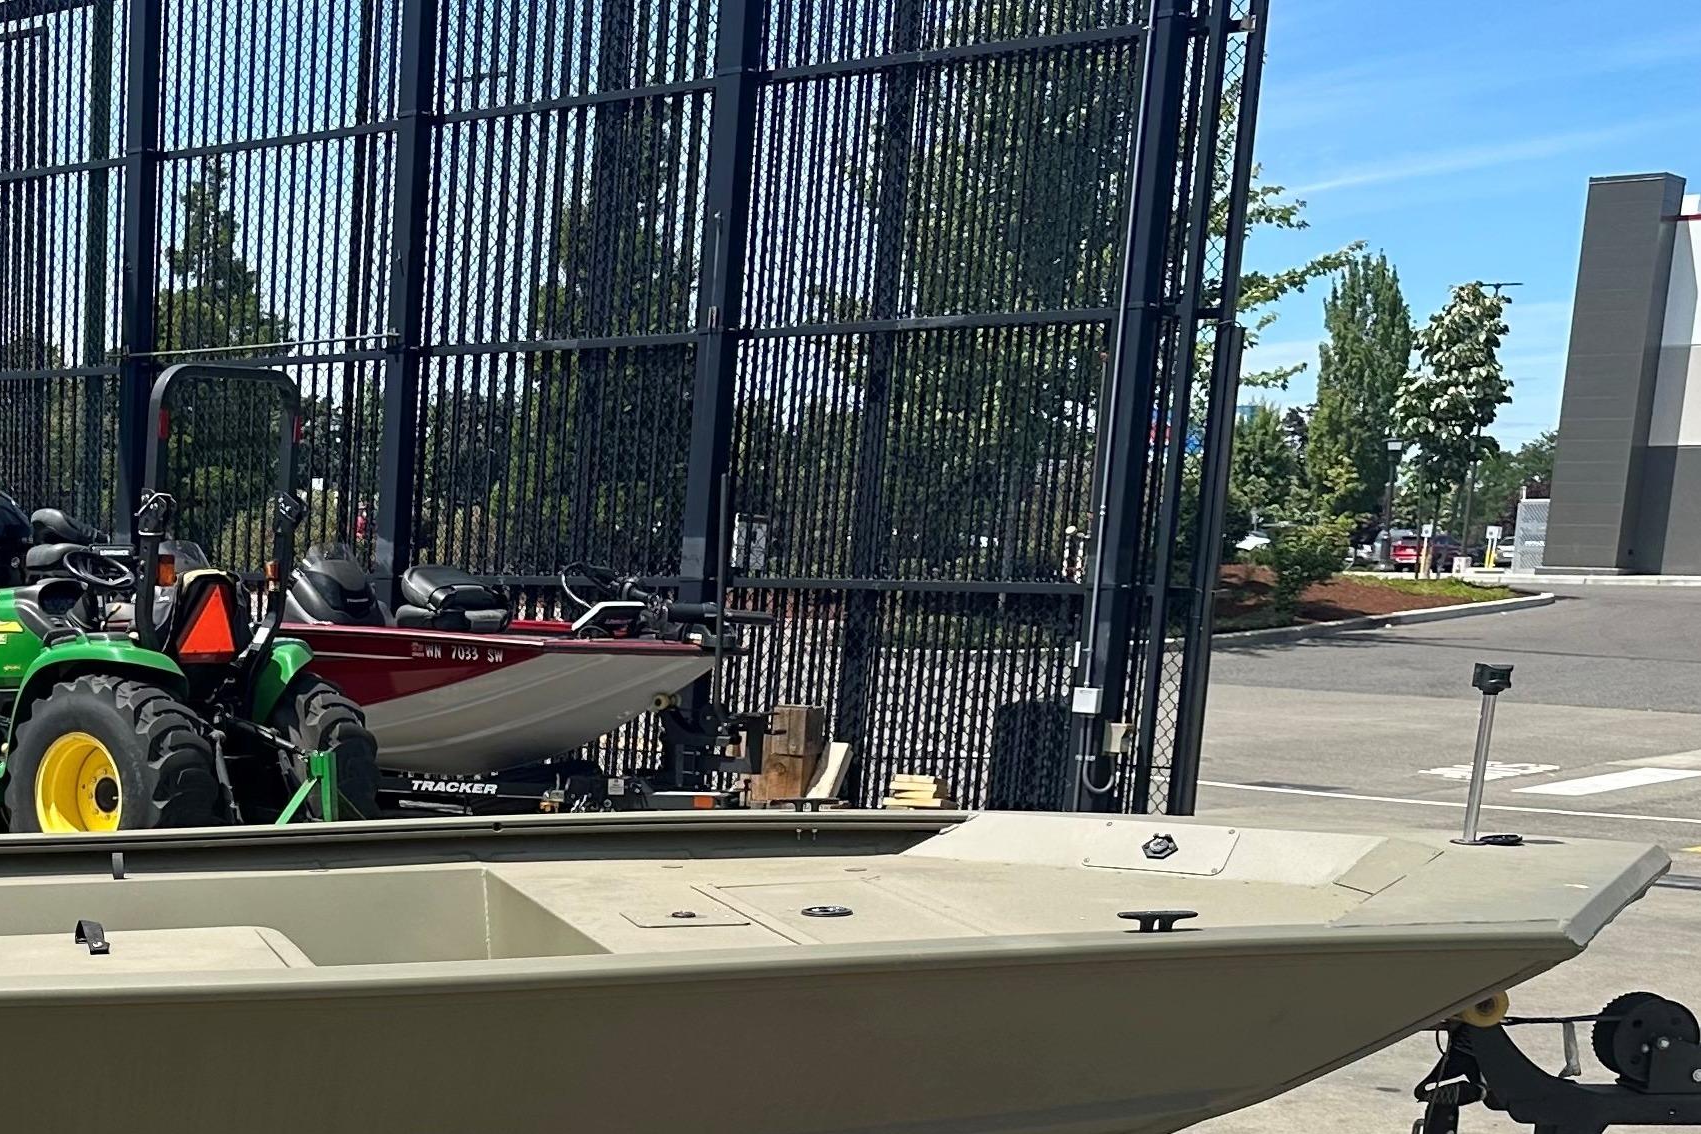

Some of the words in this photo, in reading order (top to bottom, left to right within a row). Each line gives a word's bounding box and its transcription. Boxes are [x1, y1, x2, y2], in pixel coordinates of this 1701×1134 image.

[425, 644, 442, 659] WN
[451, 645, 479, 661] 7033
[487, 648, 504, 663] SW
[411, 780, 498, 795] TRACKER
